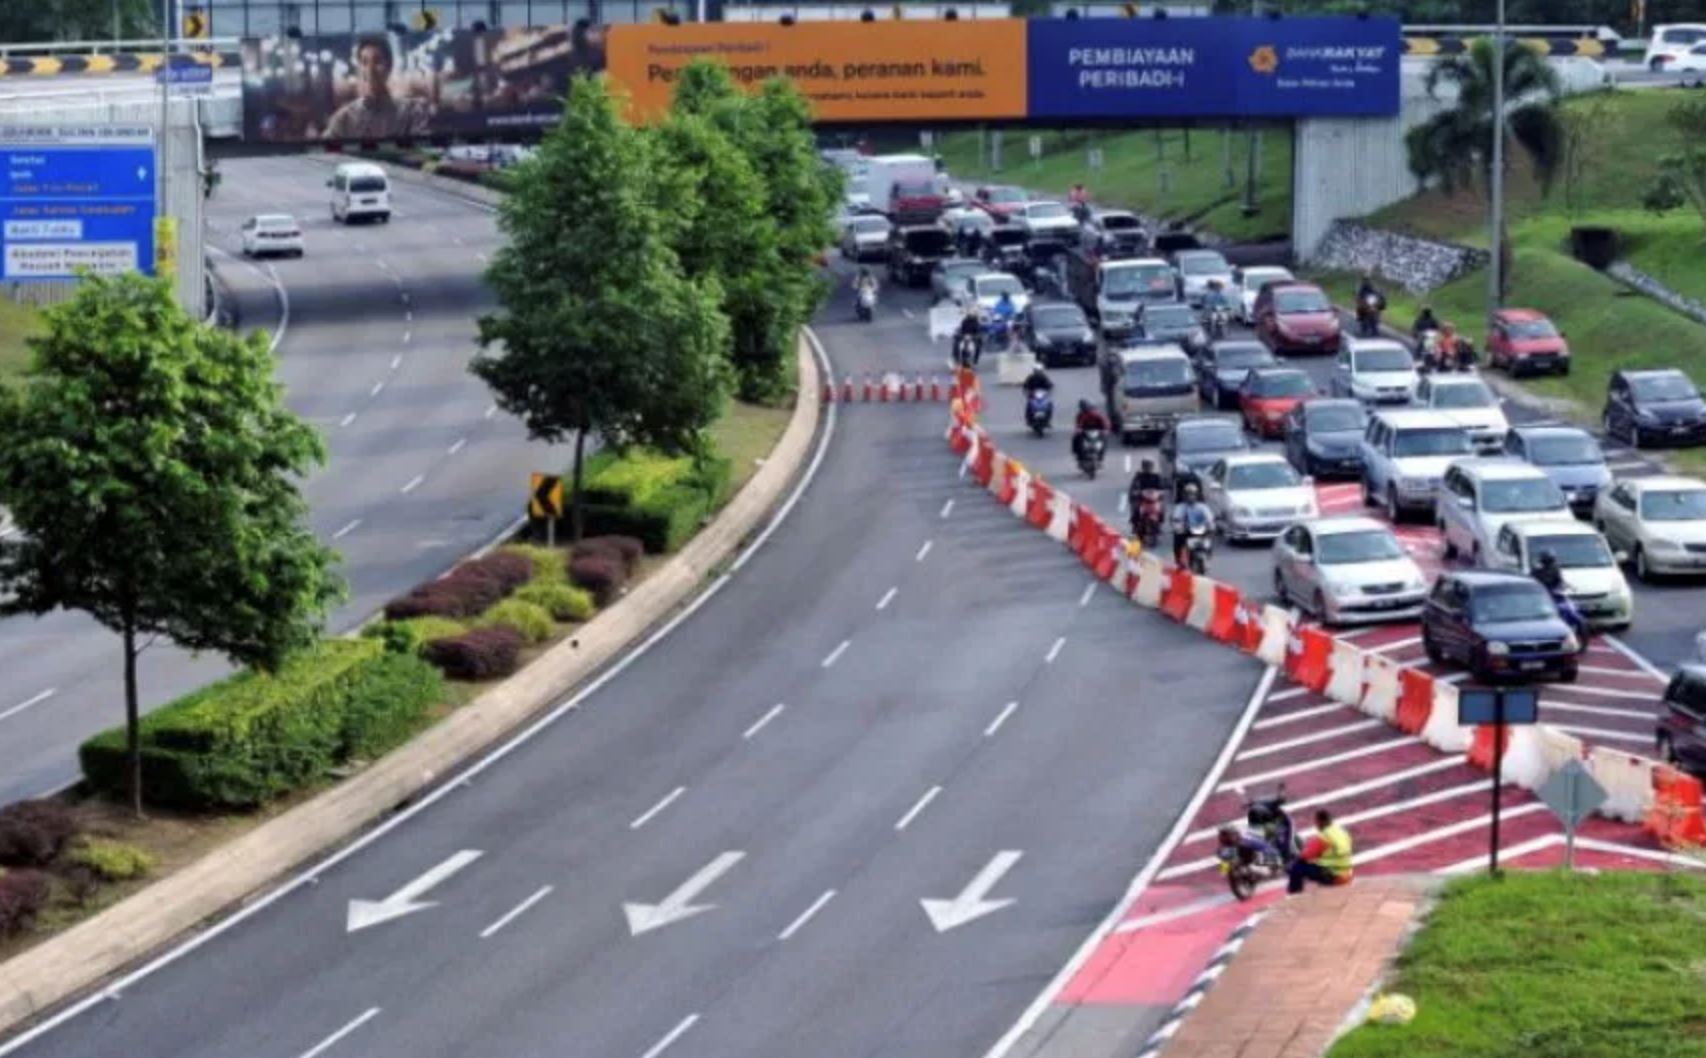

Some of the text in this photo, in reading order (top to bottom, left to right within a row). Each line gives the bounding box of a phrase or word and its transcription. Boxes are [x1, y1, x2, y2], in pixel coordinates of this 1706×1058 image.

[1069, 47, 1194, 65] PEMBIAYAAN
[843, 62, 923, 80] peranan
[930, 57, 985, 76] kami.
